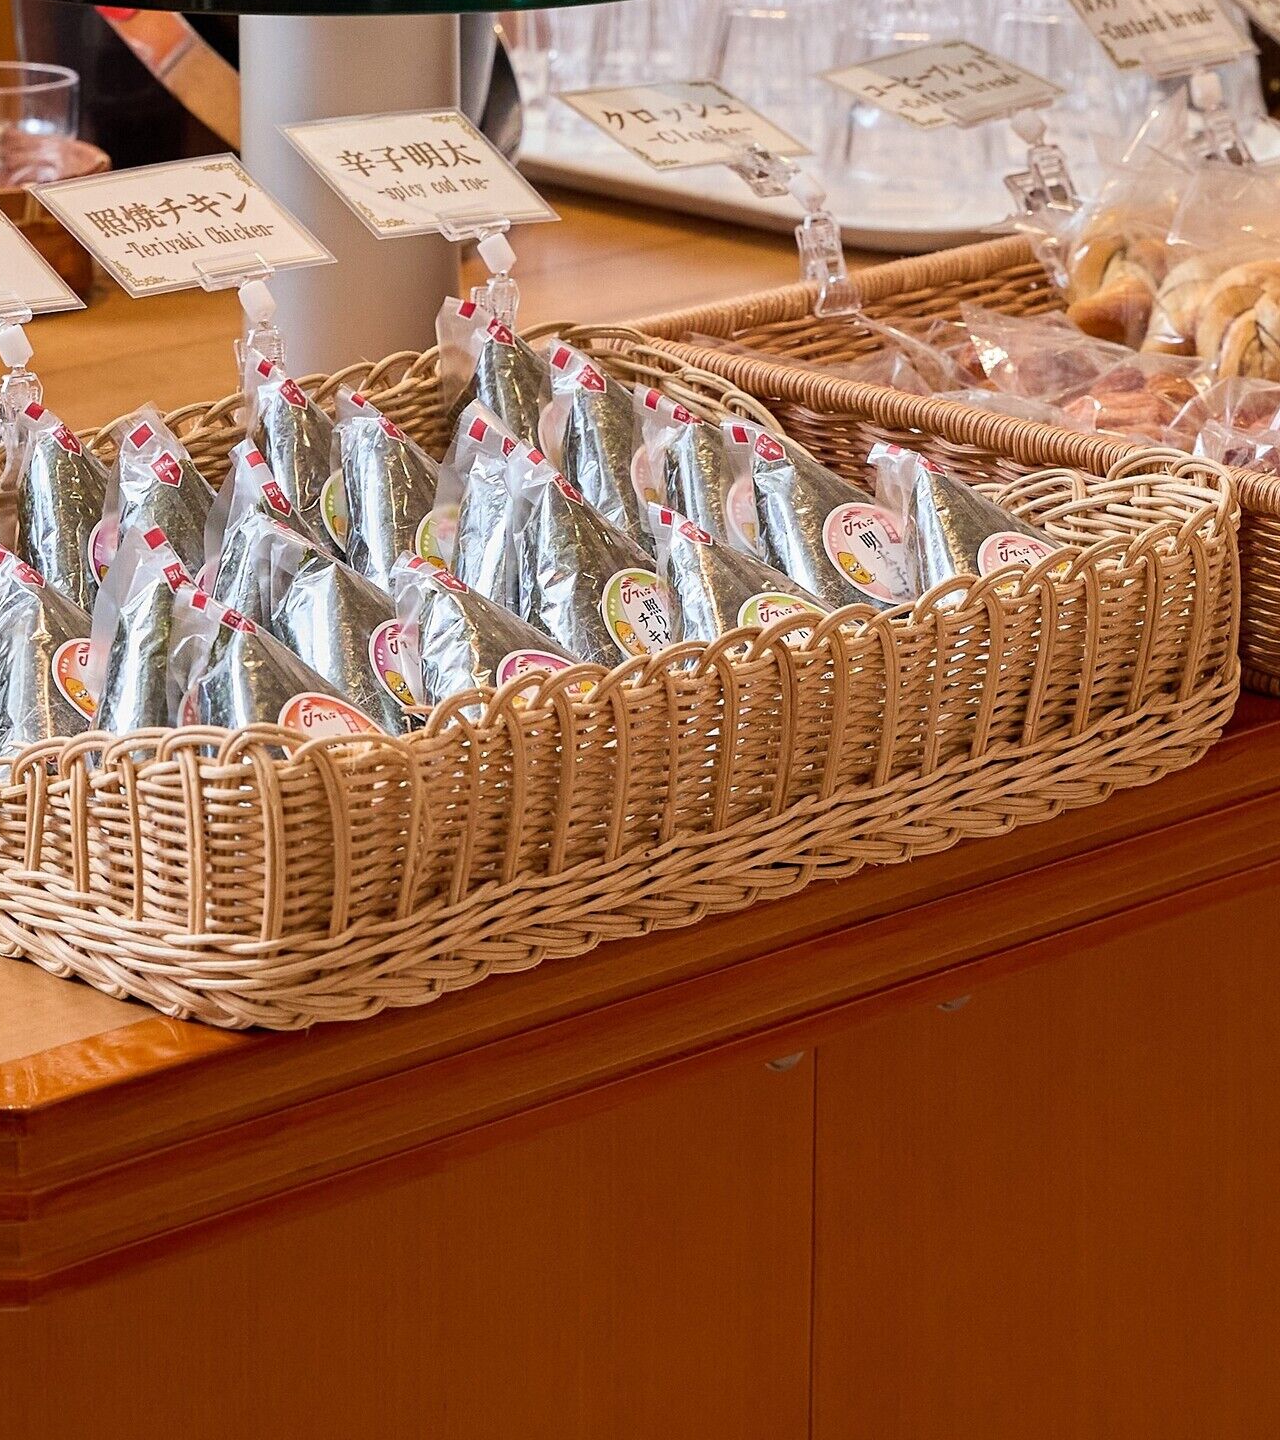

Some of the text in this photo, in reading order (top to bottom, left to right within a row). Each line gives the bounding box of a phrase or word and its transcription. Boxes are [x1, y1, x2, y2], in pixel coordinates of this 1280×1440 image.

[600, 102, 742, 131] クロッシュ
[335, 138, 482, 178] 辛子明太
[433, 175, 459, 196] cod
[83, 189, 248, 239] 照焼チキン
